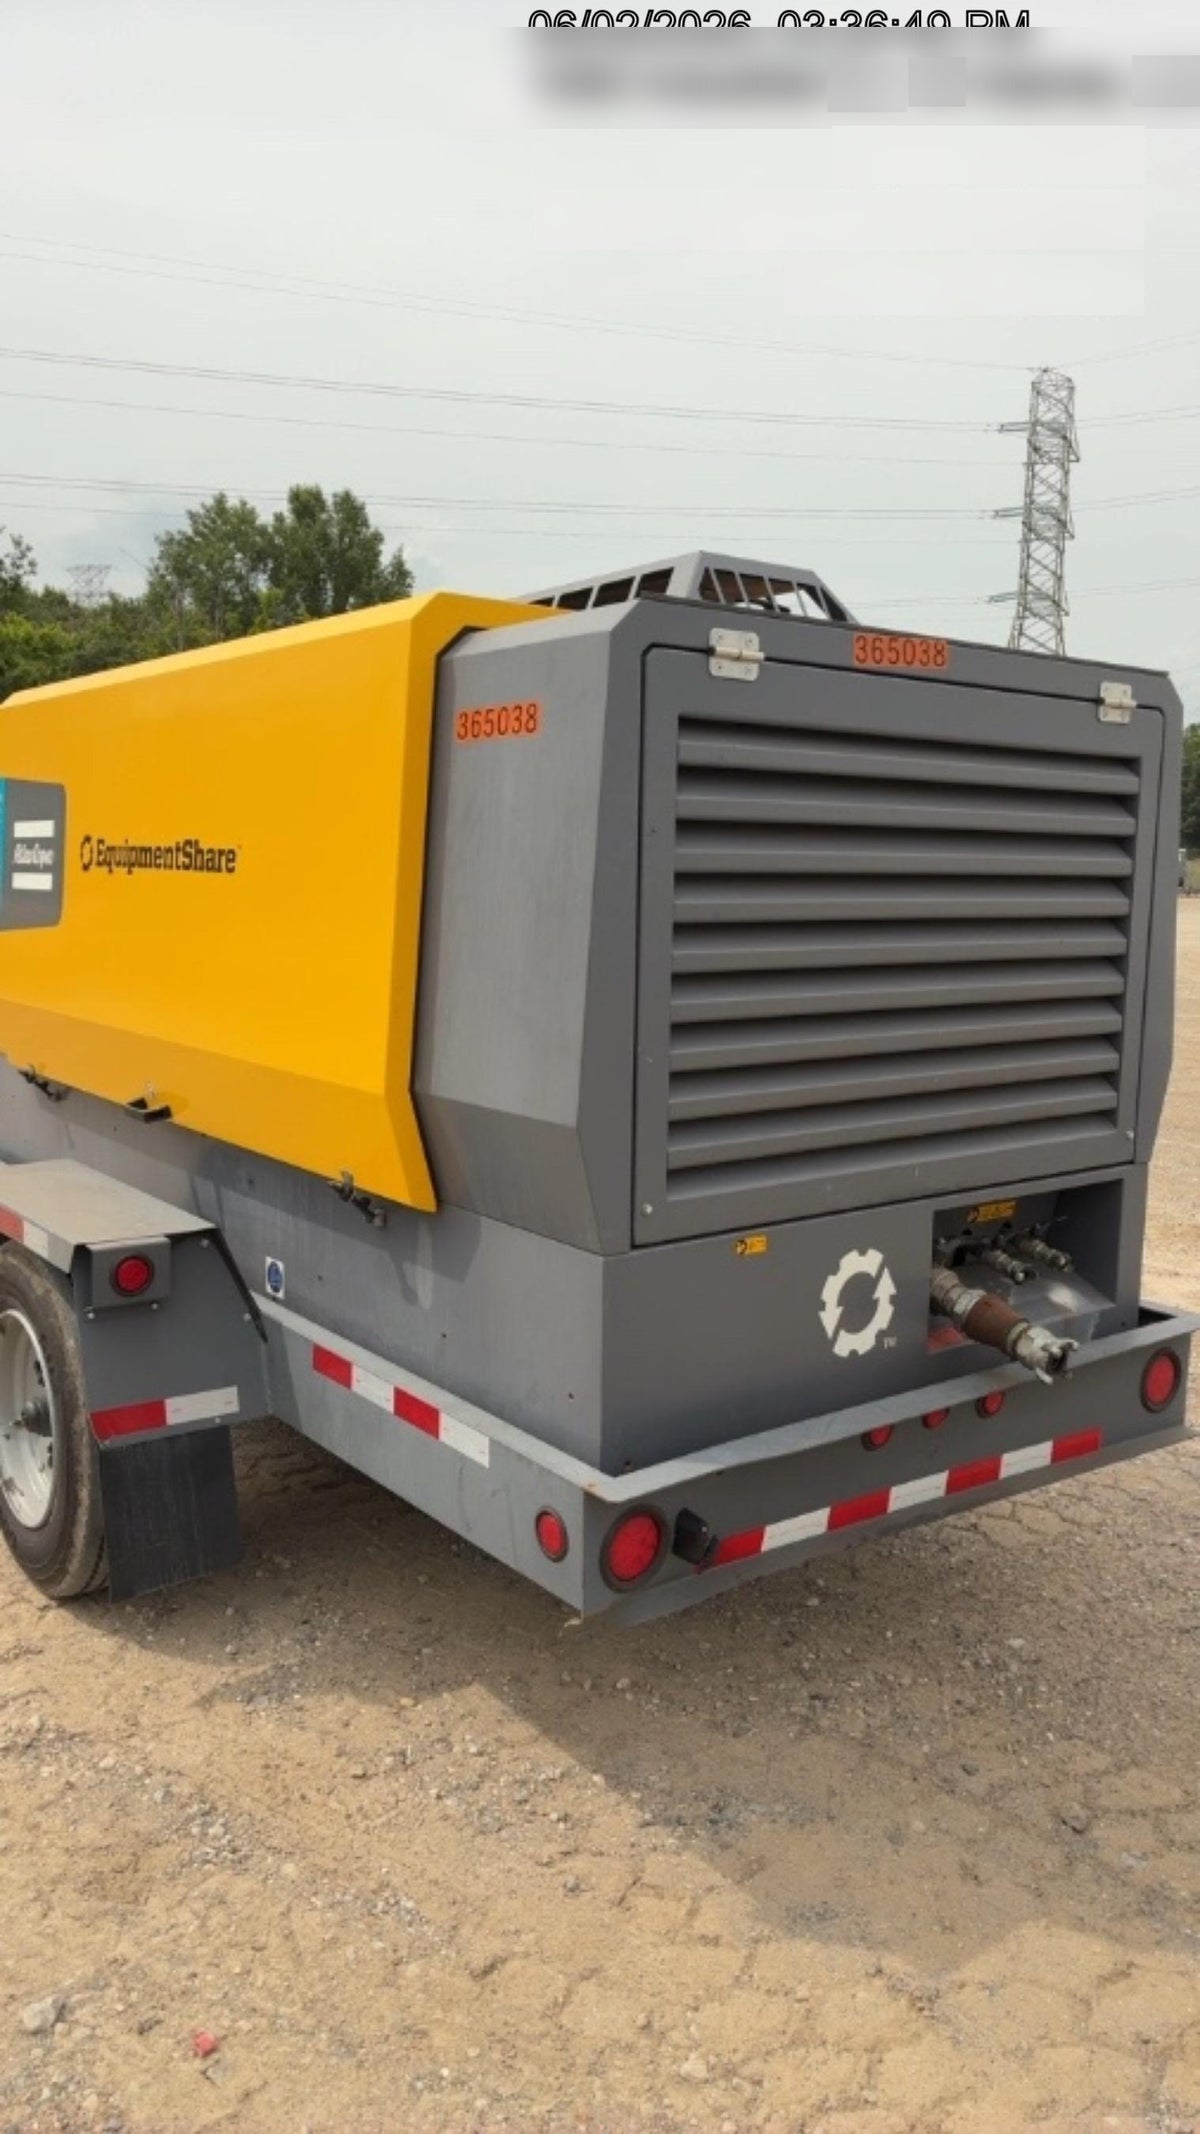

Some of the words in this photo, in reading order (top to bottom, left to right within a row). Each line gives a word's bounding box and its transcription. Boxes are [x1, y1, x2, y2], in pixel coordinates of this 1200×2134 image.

[854, 634, 946, 667] 365038
[456, 702, 537, 740] 365038
[96, 838, 237, 875] EquipmentShare
